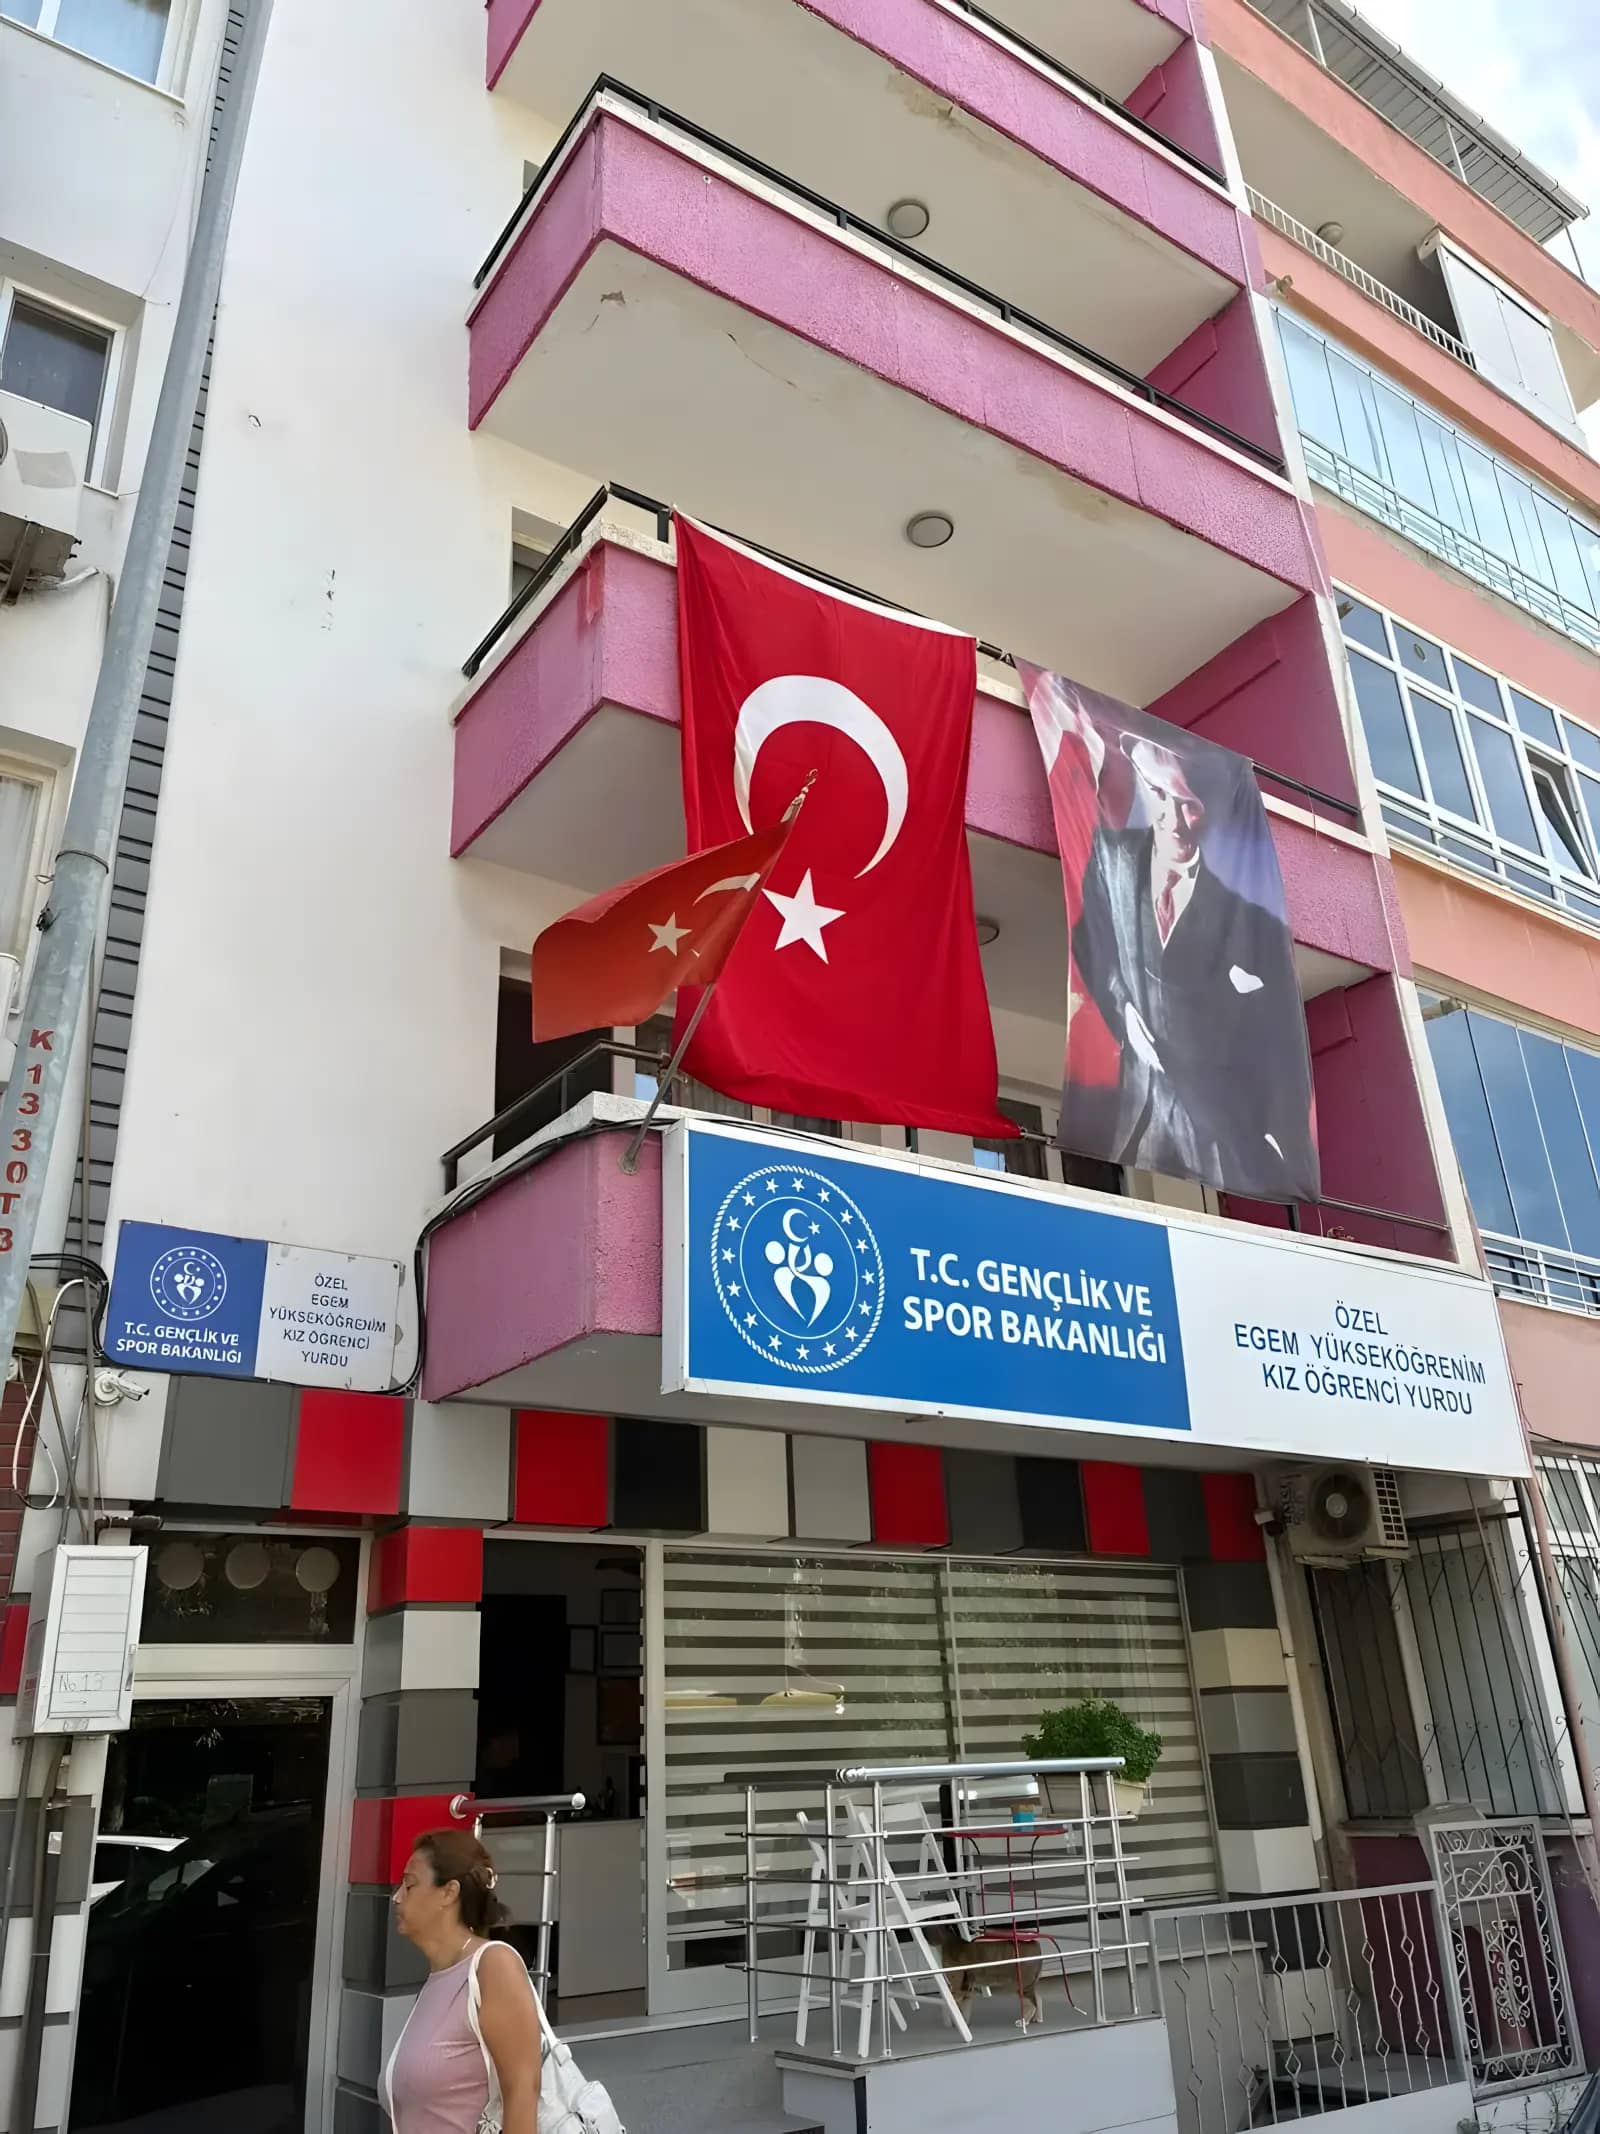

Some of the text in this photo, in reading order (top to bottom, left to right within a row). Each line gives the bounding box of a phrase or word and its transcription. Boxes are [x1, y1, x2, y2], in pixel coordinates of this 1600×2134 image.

[314, 1273, 349, 1291] ÖZEL
[910, 1246, 1154, 1317] T.C. GENÇLİK VE
[311, 1293, 349, 1309] EGEM
[902, 1295, 1168, 1364] SPOR BAKANLIĞI
[1335, 1299, 1390, 1336] ÖZEL
[124, 1321, 240, 1346] T.C. GENÇLİK VE
[283, 1328, 306, 1343] KIZ
[116, 1338, 242, 1364] SPOR BAKANLIĞI
[301, 1350, 349, 1367] YURDU
[1234, 1323, 1487, 1385] EGEM YÜKSEKÖĞRENİM
[1262, 1363, 1473, 1415] KIZ ÖĞRENCİ YURDU
